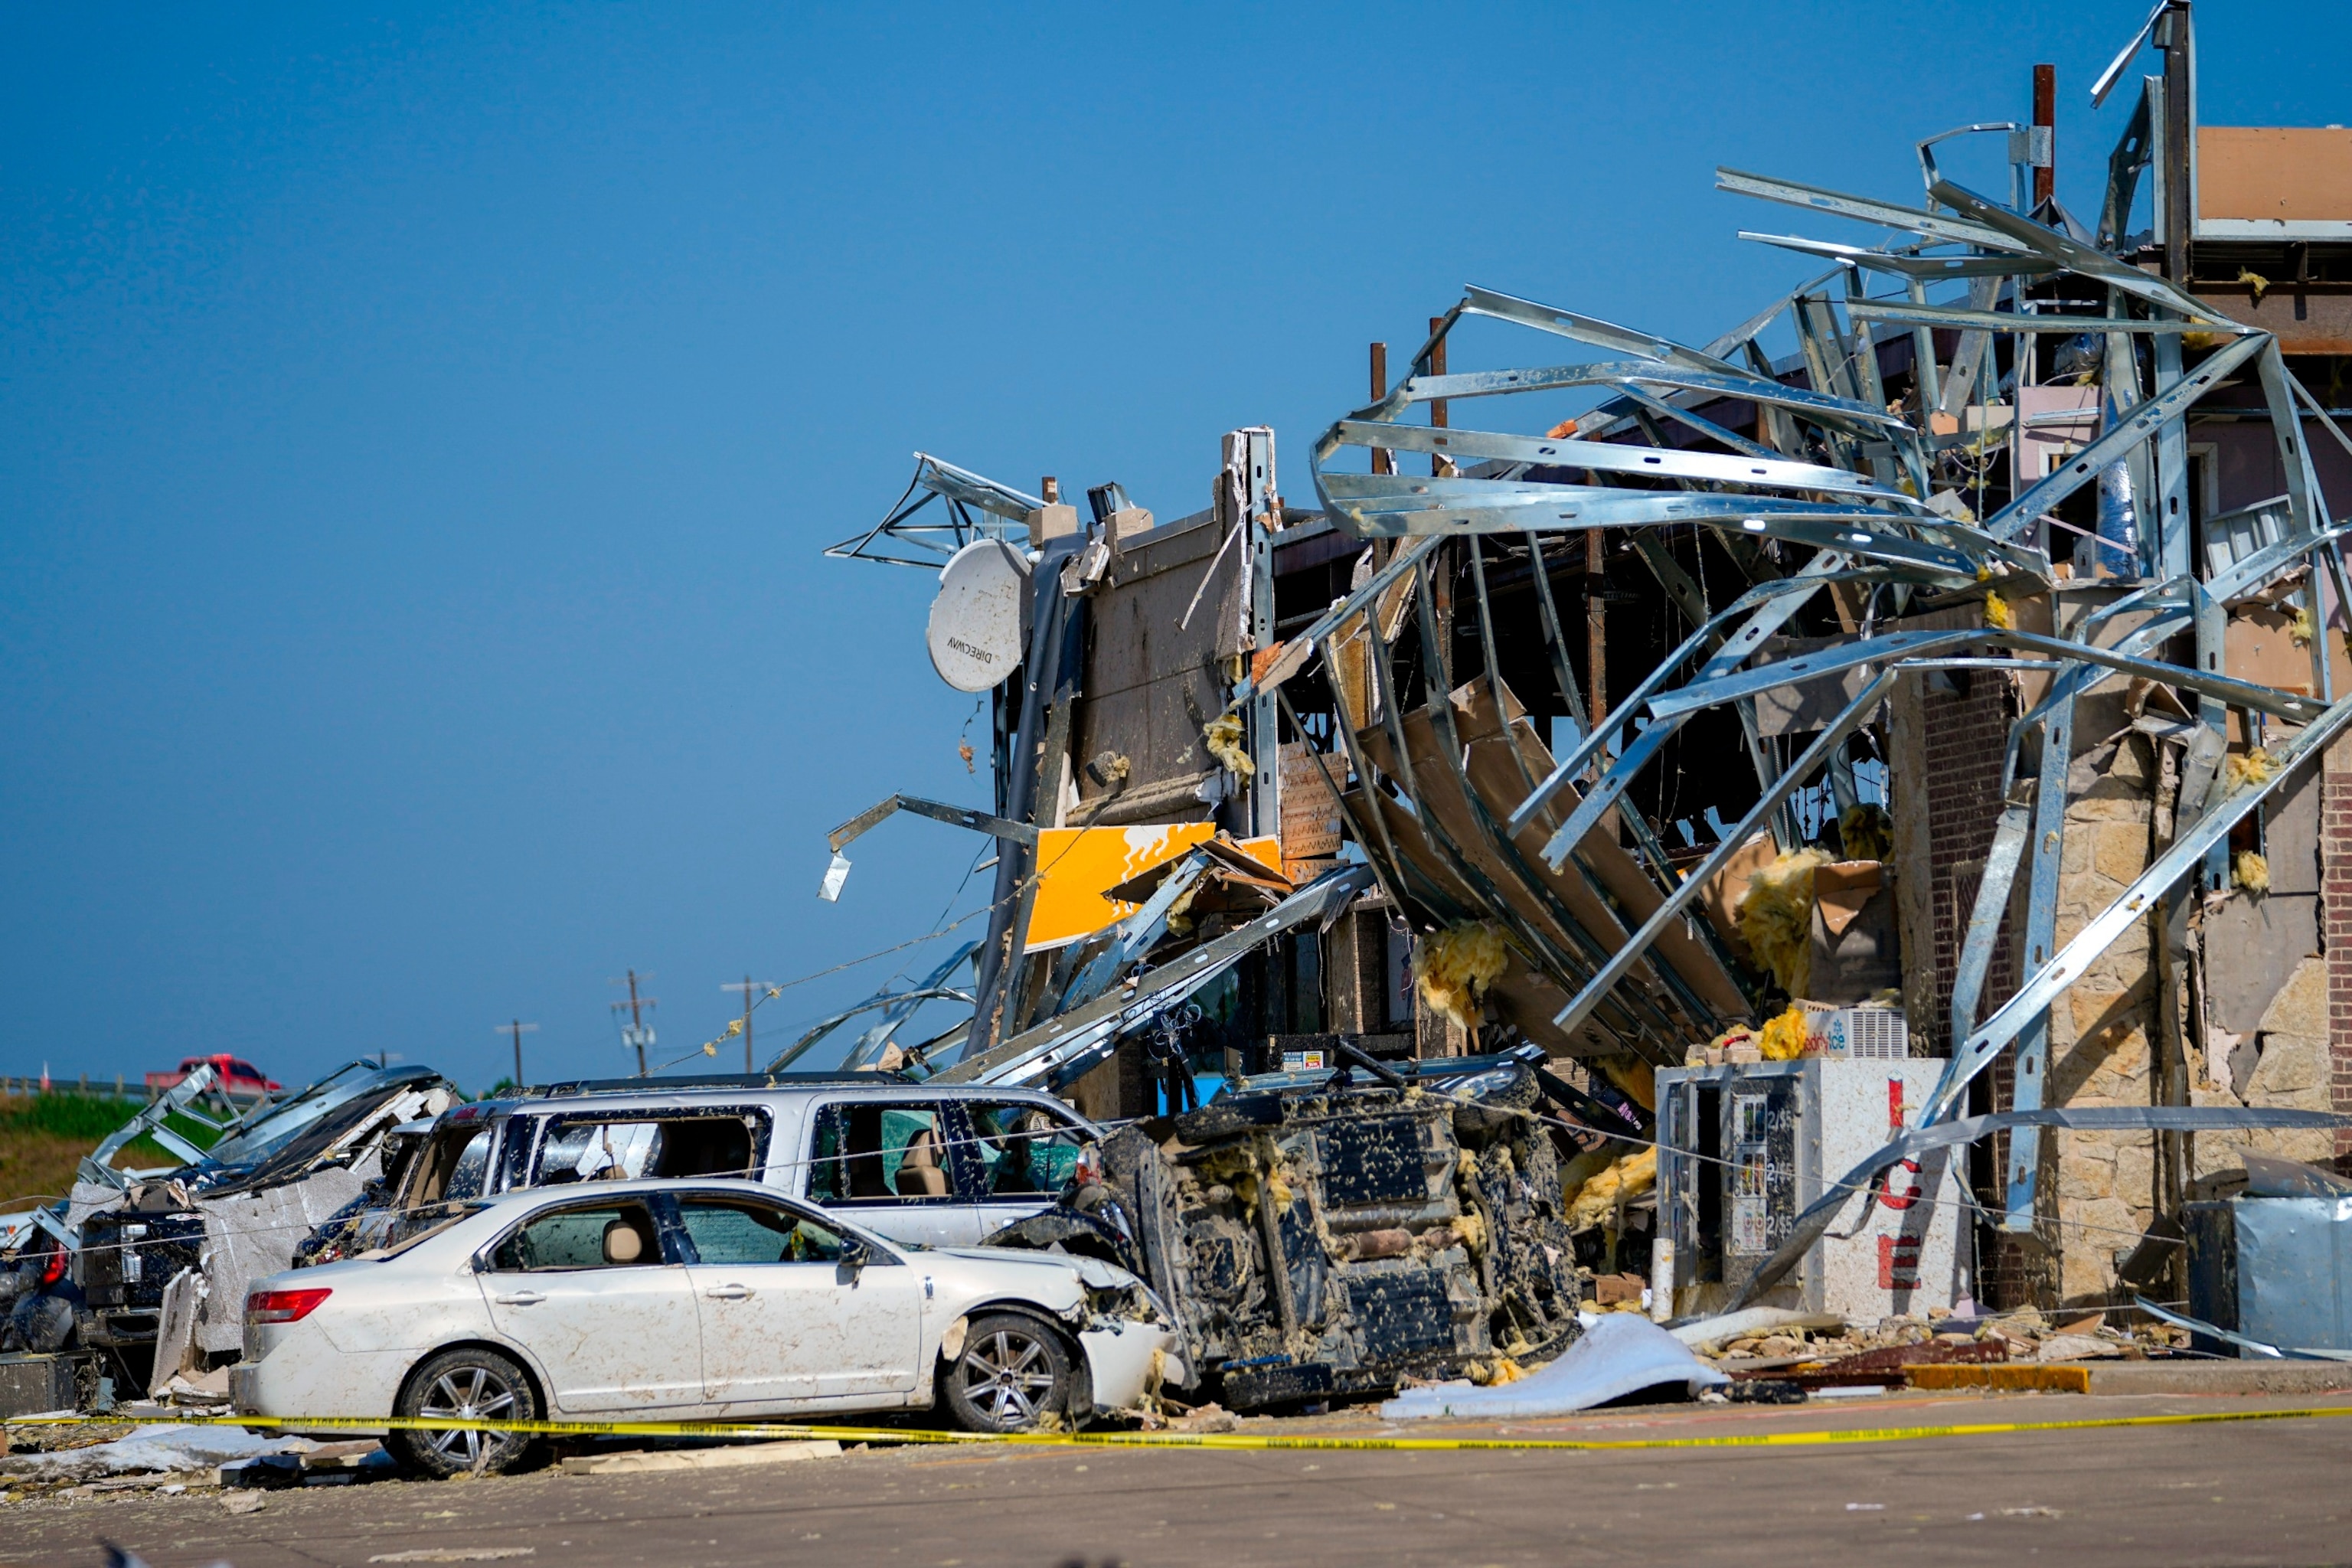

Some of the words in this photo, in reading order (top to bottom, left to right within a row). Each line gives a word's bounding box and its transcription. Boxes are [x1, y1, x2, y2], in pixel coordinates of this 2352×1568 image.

[1768, 1108, 1792, 1132] 2/$5
[1877, 1070, 1922, 1289] ICE
[1766, 1212, 1793, 1240] 2/$5
[1338, 1439, 1359, 1448] LINE
